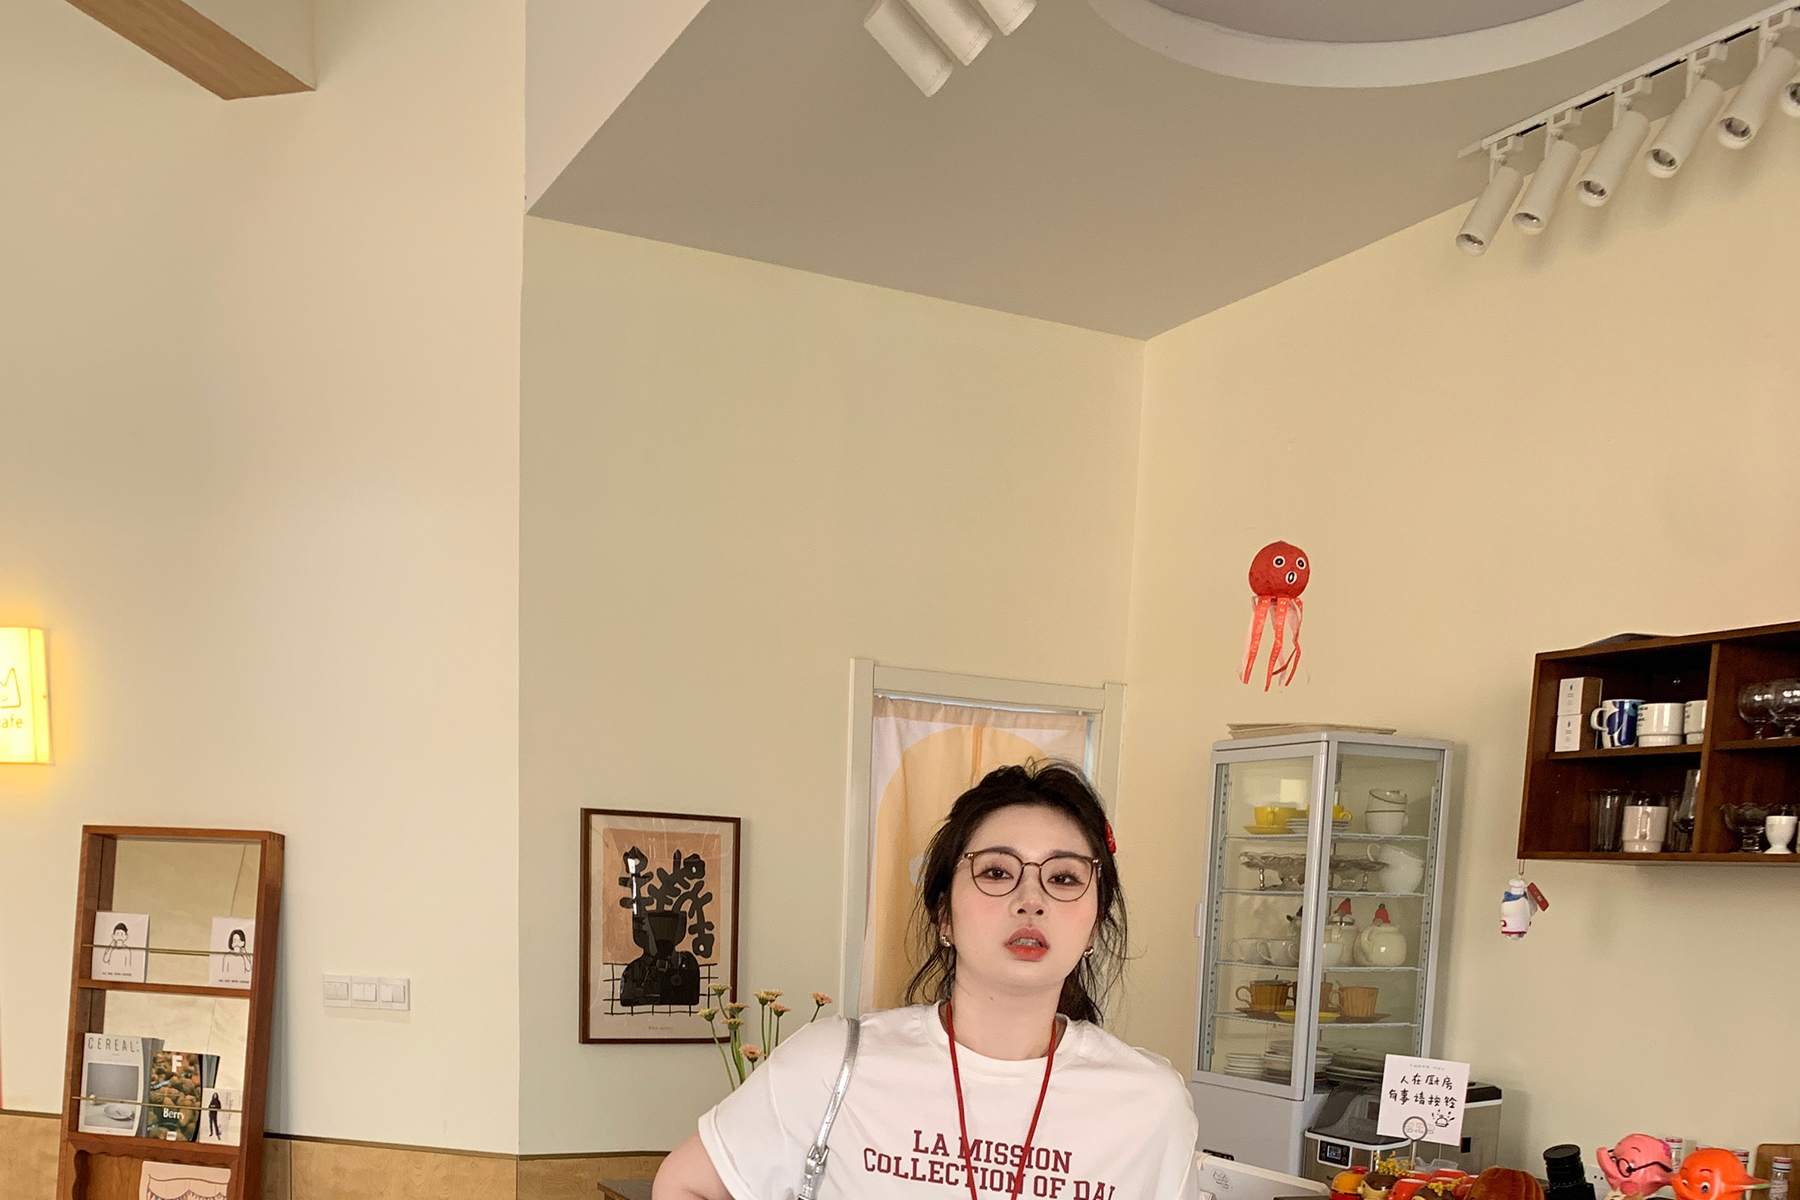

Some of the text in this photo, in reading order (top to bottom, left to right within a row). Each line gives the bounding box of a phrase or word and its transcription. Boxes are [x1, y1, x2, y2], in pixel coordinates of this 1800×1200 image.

[87, 1036, 135, 1052] CEREAL
[171, 1054, 184, 1073] F
[1400, 1073, 1454, 1090] 人在厨房
[1388, 1088, 1458, 1109] 有事请按铃
[162, 1107, 185, 1121] Berry
[912, 1129, 1073, 1175] LA MISSION
[863, 1147, 1027, 1195] COLLECTION
[1033, 1175, 1066, 1199] OF
